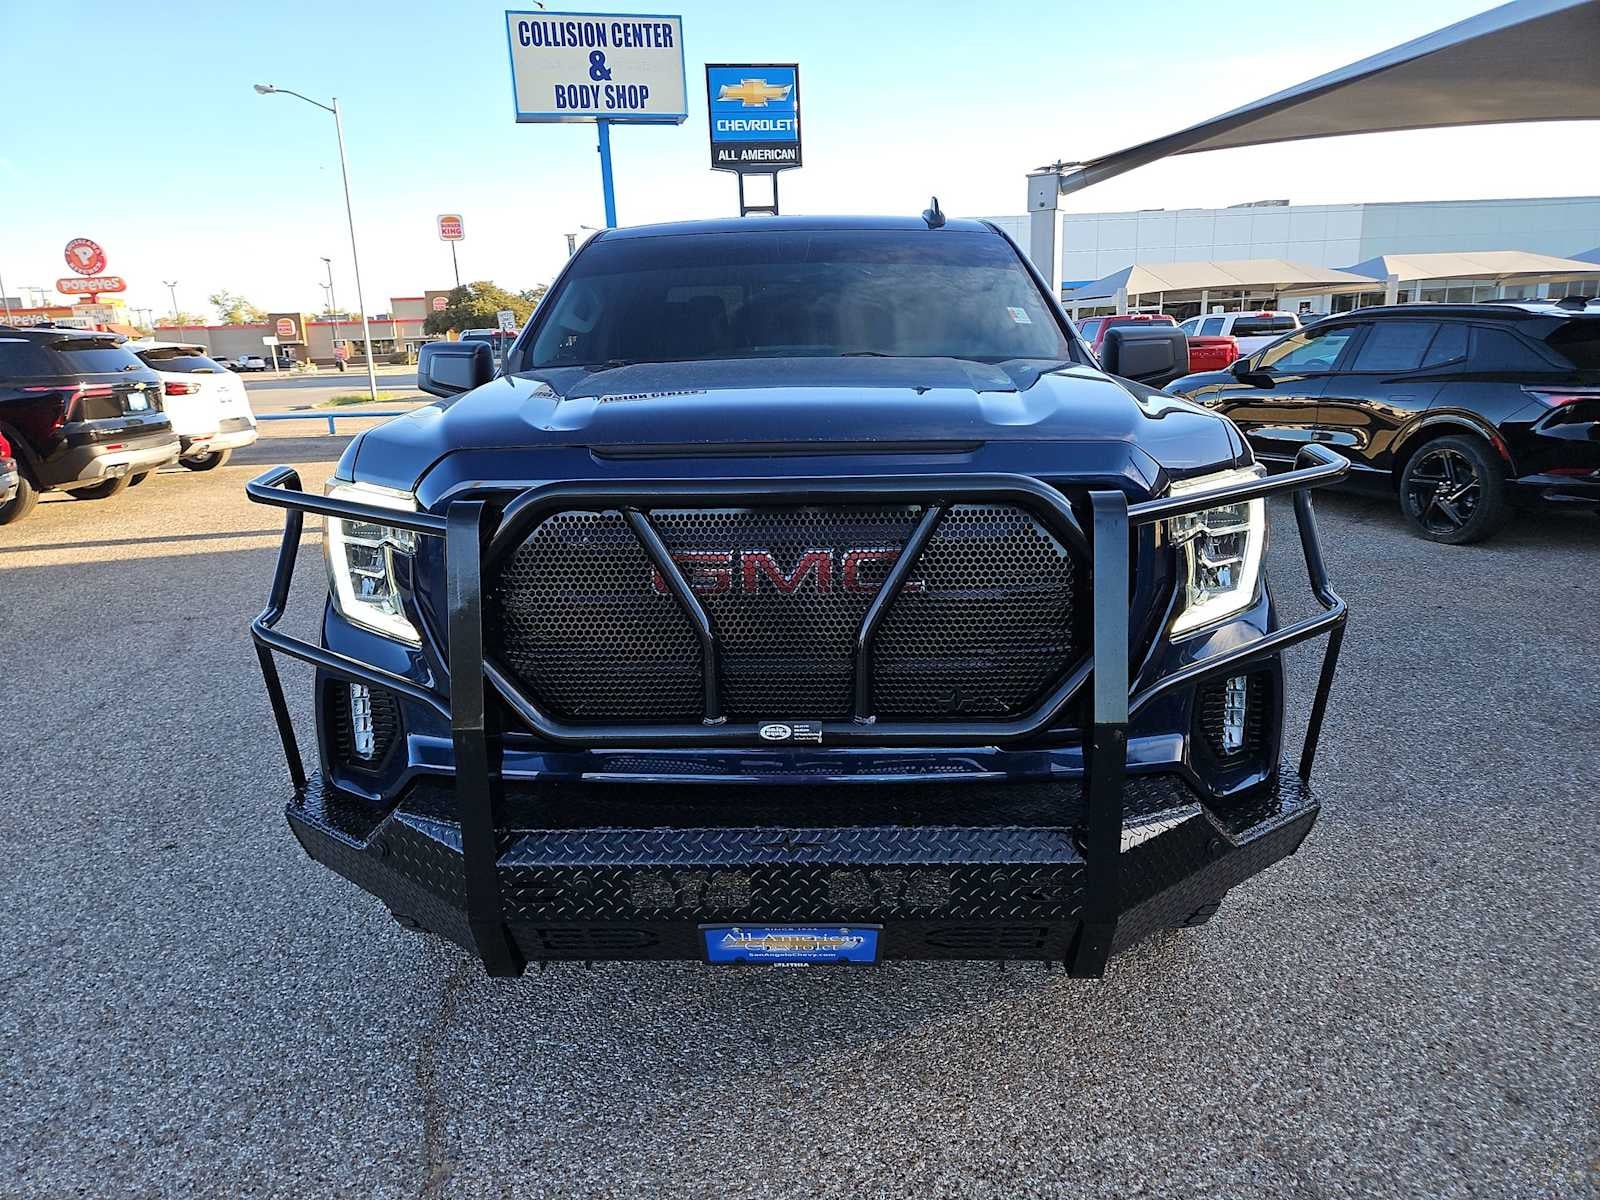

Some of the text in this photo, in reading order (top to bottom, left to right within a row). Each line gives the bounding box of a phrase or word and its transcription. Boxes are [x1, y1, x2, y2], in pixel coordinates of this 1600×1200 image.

[518, 21, 674, 48] COLLISION CENTER
[588, 50, 612, 81] &
[555, 84, 649, 109] BODY SHOP
[716, 118, 793, 132] CHEVROLET
[718, 149, 796, 161] ALL AMERICAN
[652, 549, 925, 595] GMC
[721, 932, 864, 943] All American
[745, 942, 840, 952] Chevrolet
